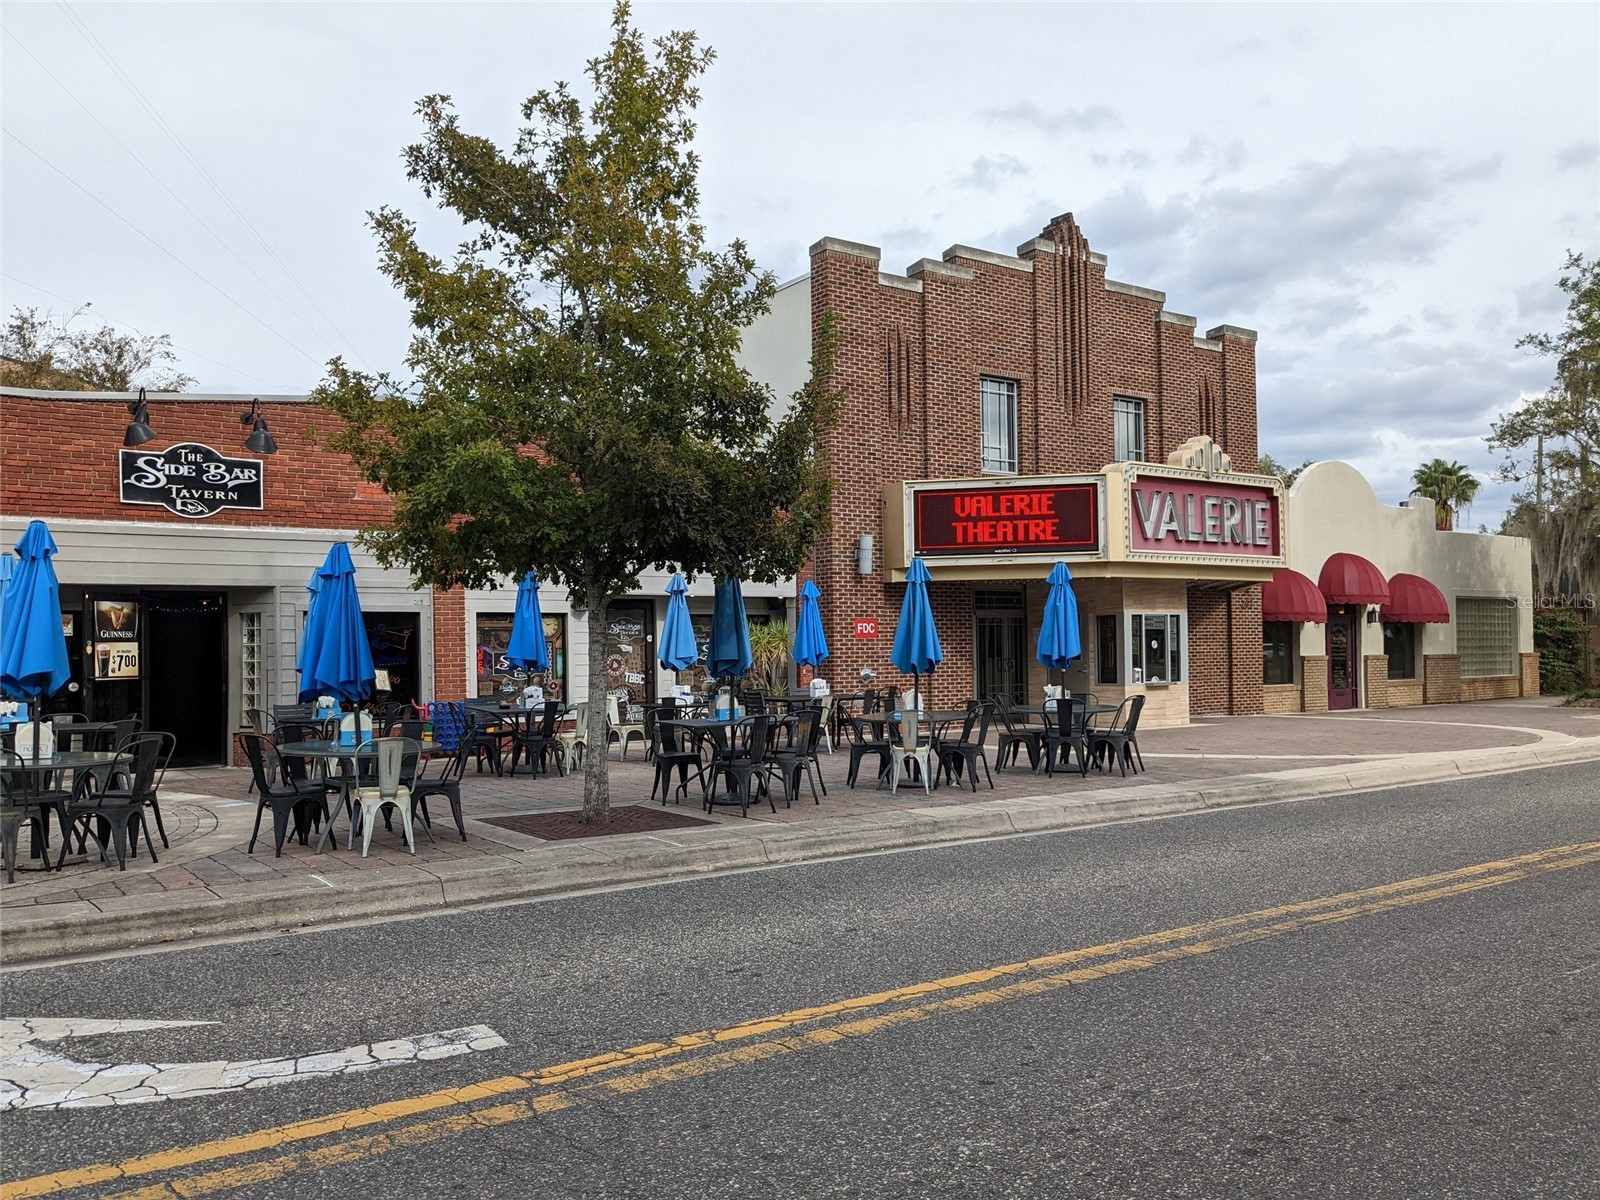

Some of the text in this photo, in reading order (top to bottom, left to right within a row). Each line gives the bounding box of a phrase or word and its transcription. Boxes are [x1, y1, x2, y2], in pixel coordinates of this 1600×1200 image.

[177, 449, 203, 464] THE
[124, 456, 258, 489] SIDE BAR
[165, 484, 238, 500] TAVERN
[954, 493, 1055, 517] VALERIE
[1131, 489, 1270, 545] VALERIE
[952, 519, 1059, 543] THEATRE
[100, 630, 134, 639] GUINNESS
[857, 623, 875, 634] FDC
[624, 672, 646, 684] TBBC
